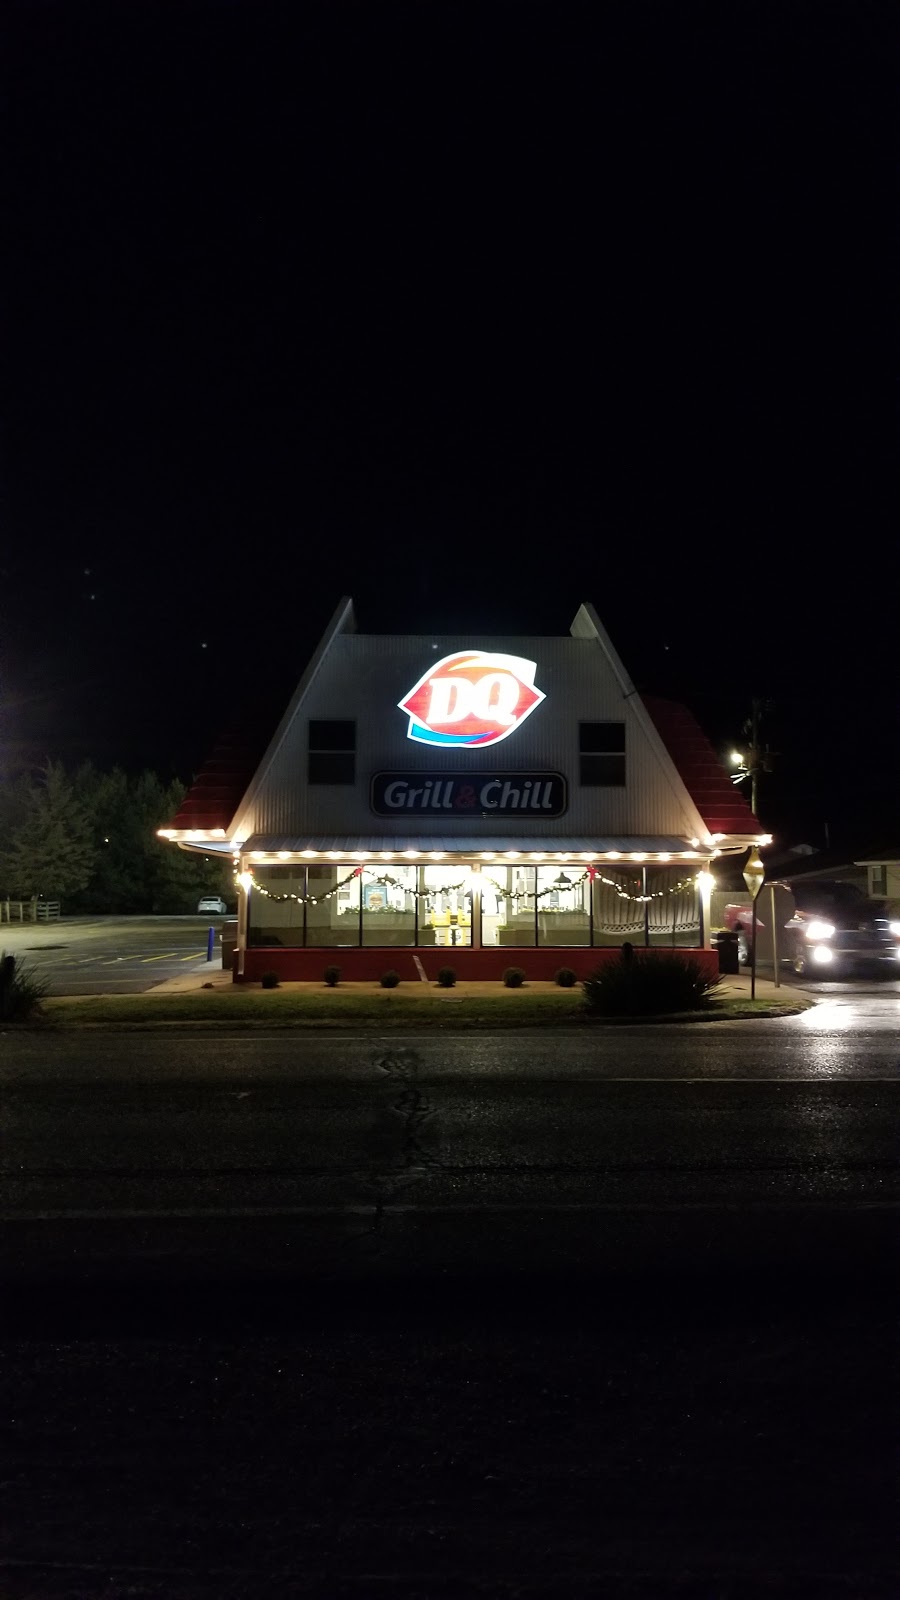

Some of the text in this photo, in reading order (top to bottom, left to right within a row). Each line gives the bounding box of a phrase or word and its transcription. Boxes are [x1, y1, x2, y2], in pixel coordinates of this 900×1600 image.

[427, 673, 521, 725] DQ
[384, 780, 553, 809] Grill & Chill
